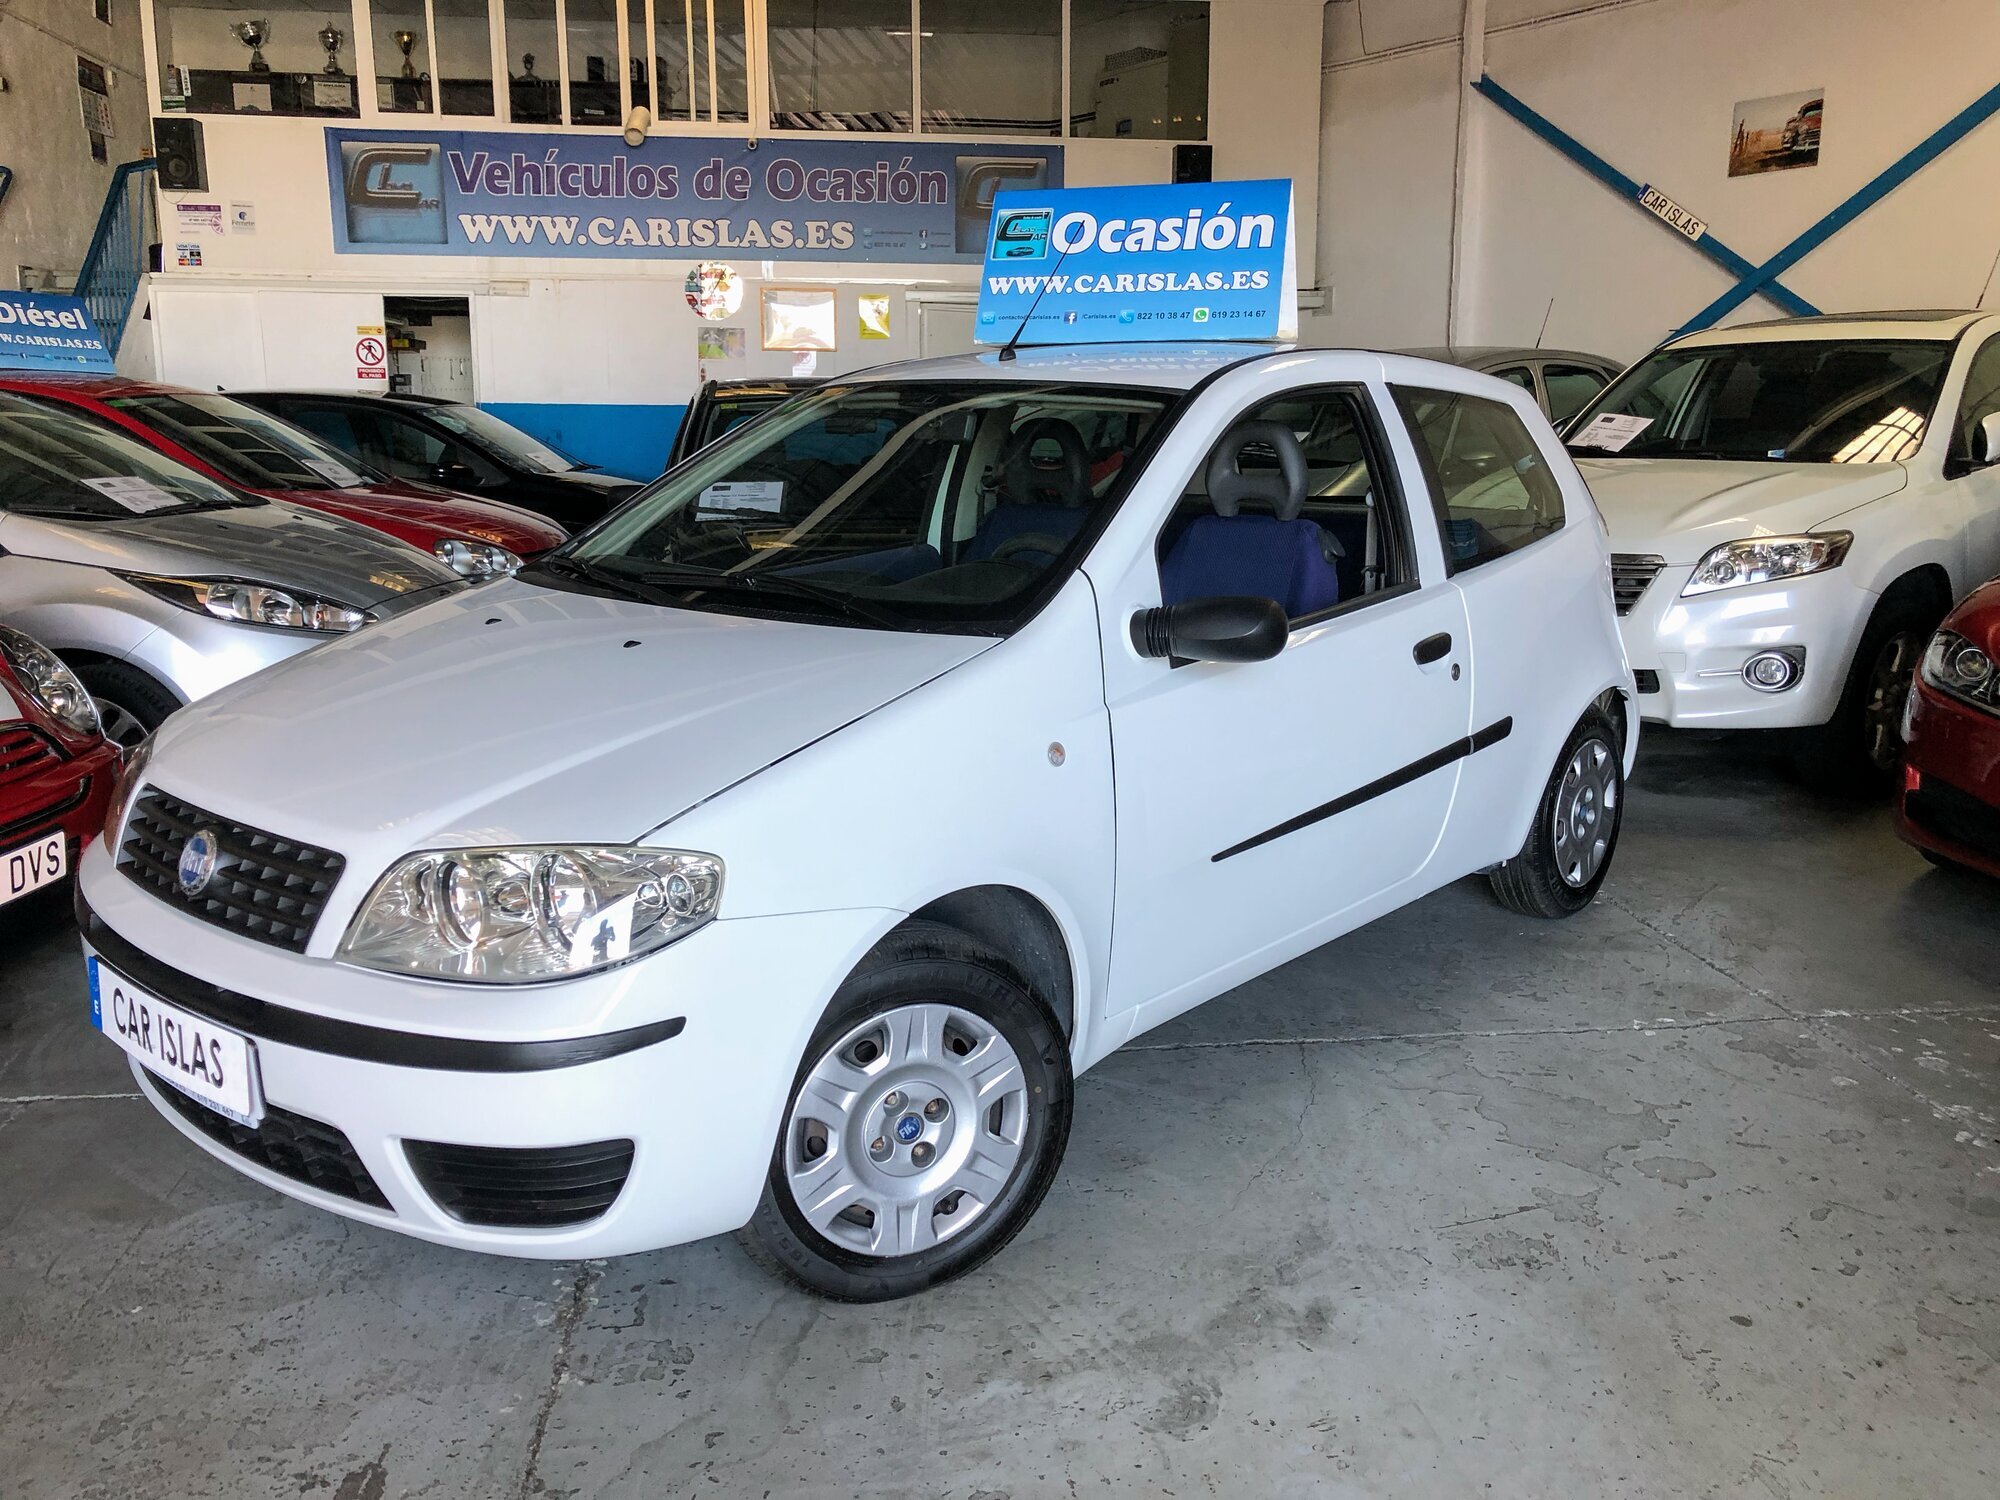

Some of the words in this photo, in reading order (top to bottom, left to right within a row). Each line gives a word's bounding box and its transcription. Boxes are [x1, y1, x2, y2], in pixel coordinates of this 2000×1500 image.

[447, 148, 679, 200] Vehículos
[693, 157, 751, 200] de
[766, 156, 948, 203] Ocasión
[457, 213, 855, 250] WWW.CARISLAS.ES
[1052, 202, 1275, 254] Ocasión
[1643, 191, 1667, 213] CAR
[1664, 205, 1699, 235] ISLAS
[988, 271, 1270, 295] WWW.CARISLAS.ES
[1136, 312, 1153, 320] 822
[1180, 311, 1191, 319] 47
[1211, 311, 1227, 319] 619
[1255, 310, 1266, 318] 67
[10, 841, 60, 894] DVS
[94, 1000, 99, 1015] E
[113, 987, 153, 1054] CAR
[157, 1014, 224, 1089] ISLAS
